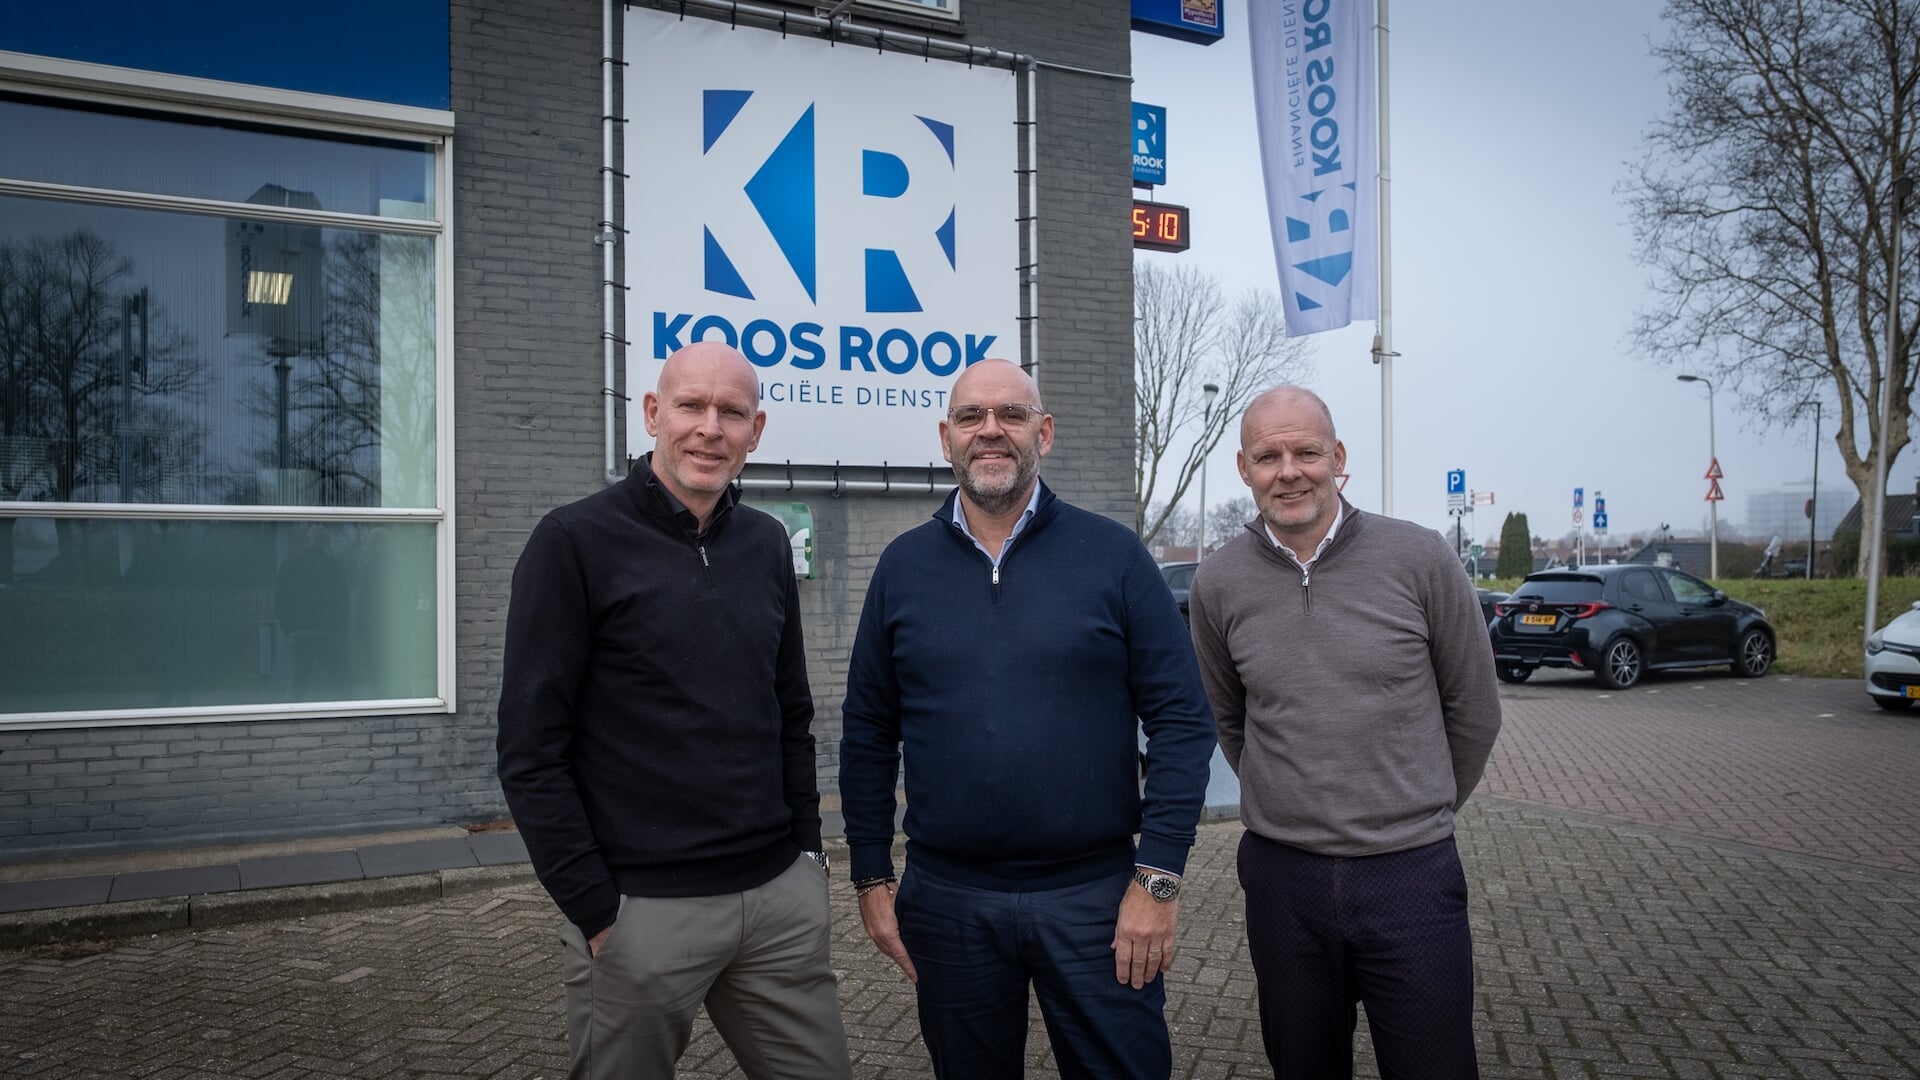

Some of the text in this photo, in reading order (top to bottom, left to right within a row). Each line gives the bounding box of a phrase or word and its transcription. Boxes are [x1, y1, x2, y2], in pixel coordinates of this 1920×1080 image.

[1133, 154, 1163, 169] ROOK
[703, 89, 956, 313] KR
[653, 312, 826, 369] KOOS
[857, 387, 946, 408] DIENST
[1450, 472, 1461, 492] P
